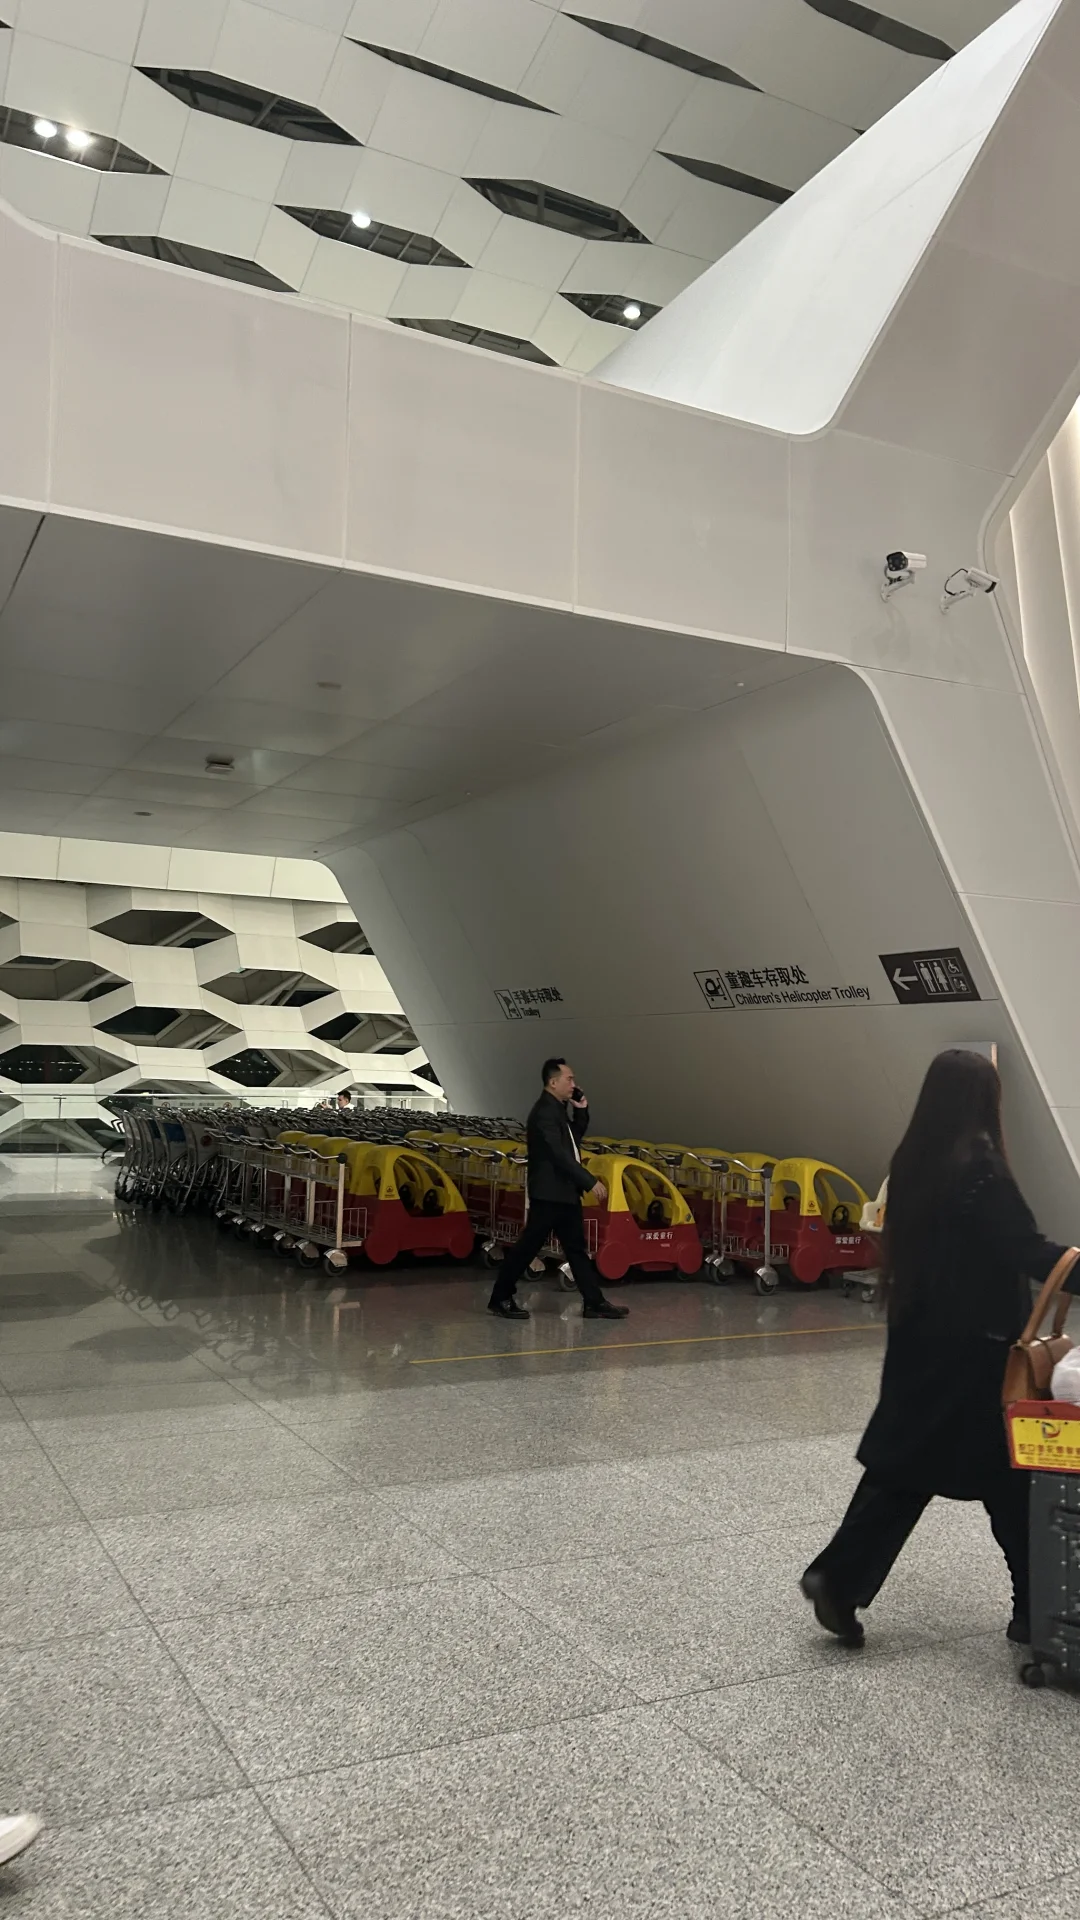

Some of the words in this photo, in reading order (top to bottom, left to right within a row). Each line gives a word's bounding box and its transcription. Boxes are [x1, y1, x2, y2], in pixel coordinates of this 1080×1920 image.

[725, 965, 810, 989] 童趣车存取处
[735, 991, 781, 1005] Children's
[782, 989, 832, 1004] Helicopter
[831, 986, 871, 1000] Trolley
